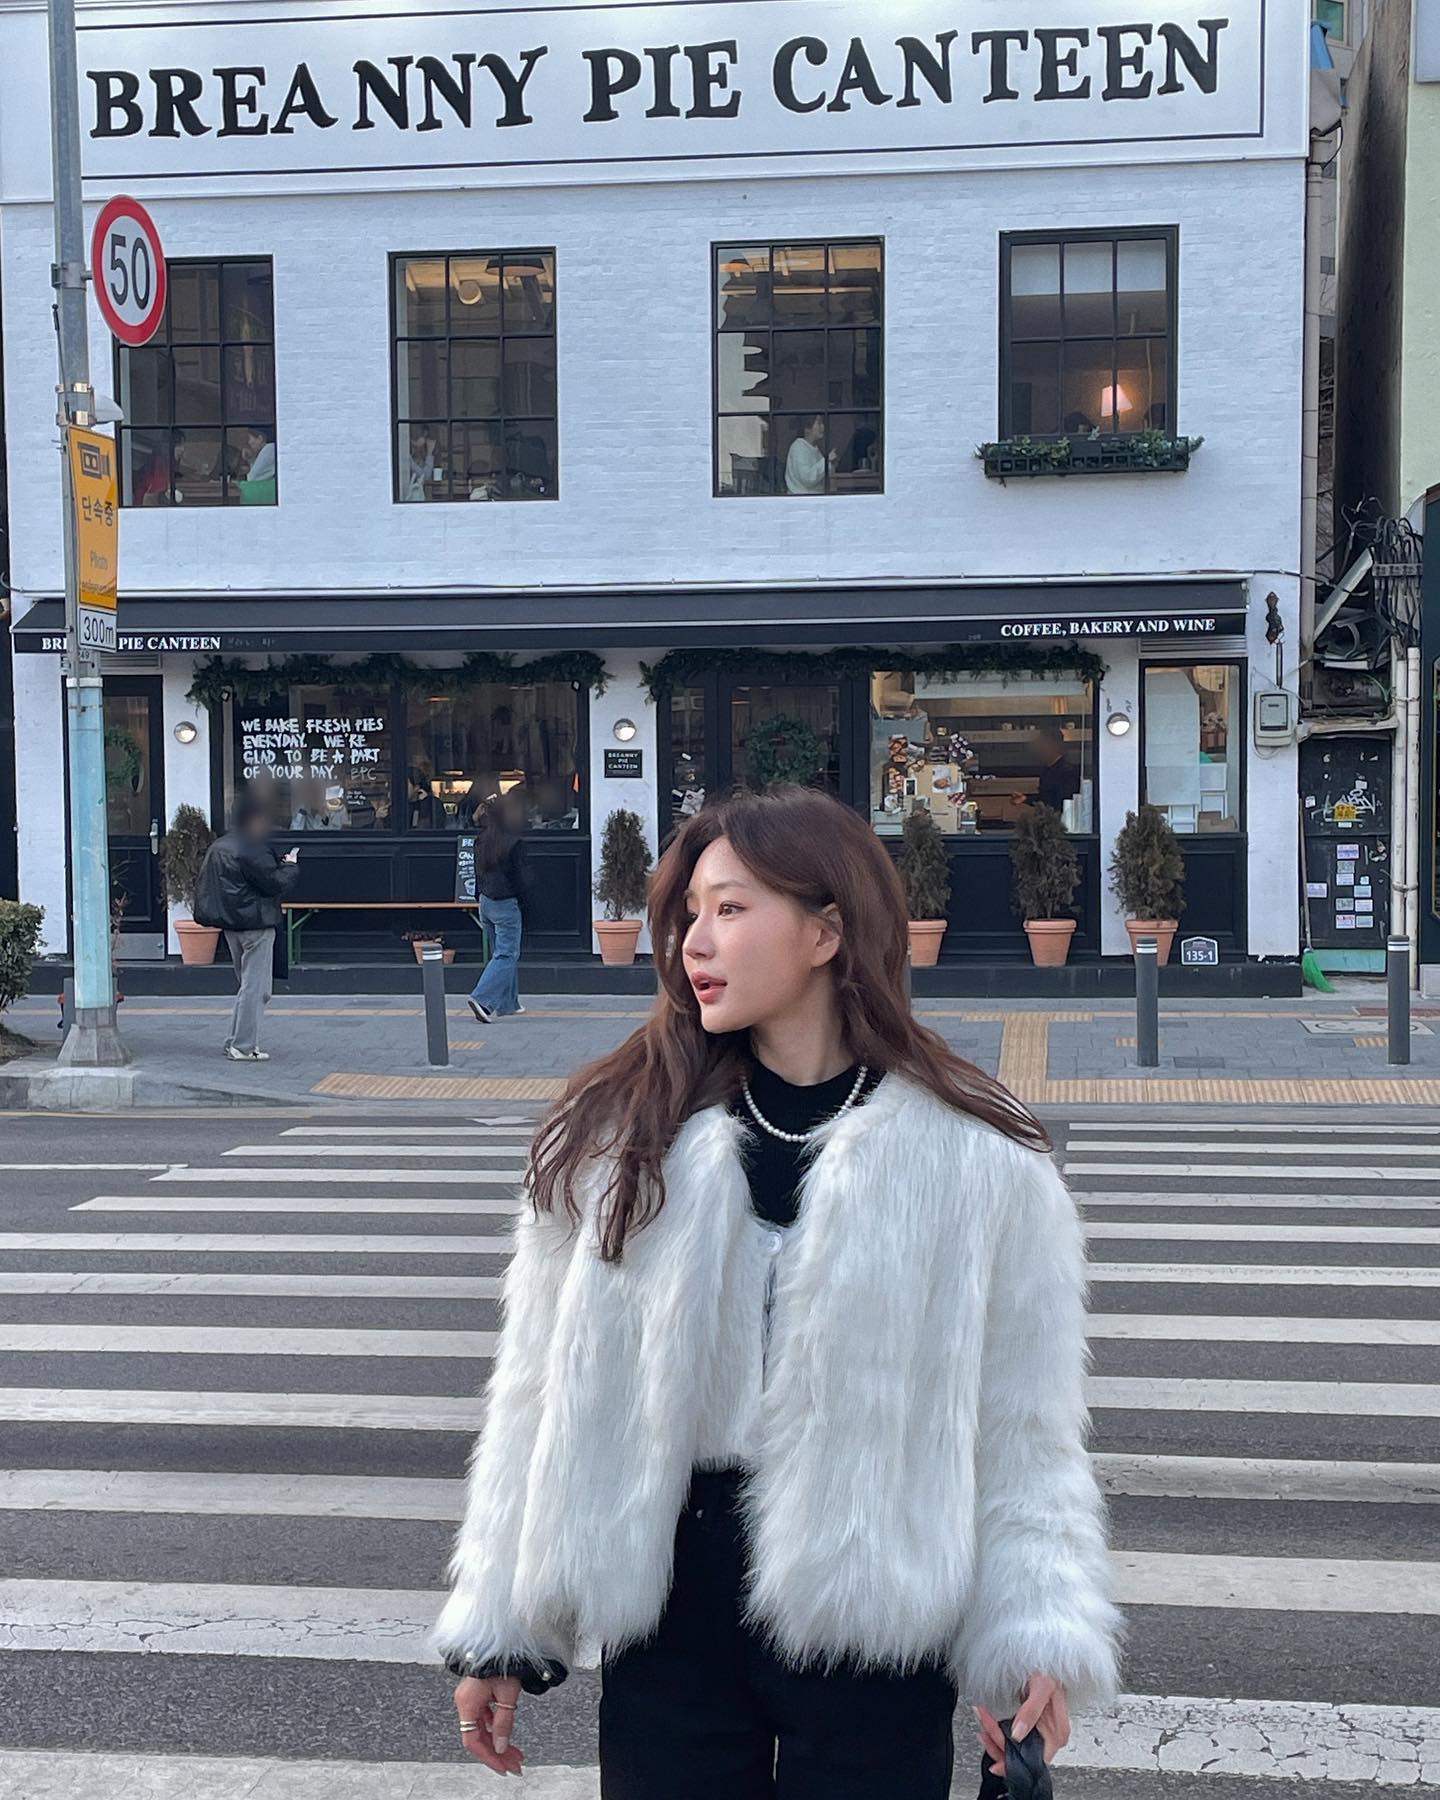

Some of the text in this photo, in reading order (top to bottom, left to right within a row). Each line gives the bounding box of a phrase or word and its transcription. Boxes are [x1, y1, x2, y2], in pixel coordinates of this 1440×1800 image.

[87, 20, 1228, 138] BREANNY PIE CANTEEN
[110, 233, 150, 310] 50
[81, 496, 114, 527] 단속중
[84, 616, 113, 643] 300m
[1000, 618, 1216, 637] COFFEE, BAKERY AND WINE
[118, 637, 144, 650] PIE
[147, 636, 221, 650] CANTEEN
[241, 718, 384, 733] WE BAKE FRESH PIES
[323, 733, 366, 748] WE'RE
[243, 748, 380, 764] GLAD TO BE A PART
[243, 766, 261, 779] OF
[268, 765, 303, 779] YOUR
[310, 765, 338, 779] DAY.
[1186, 950, 1213, 961] 135-1
